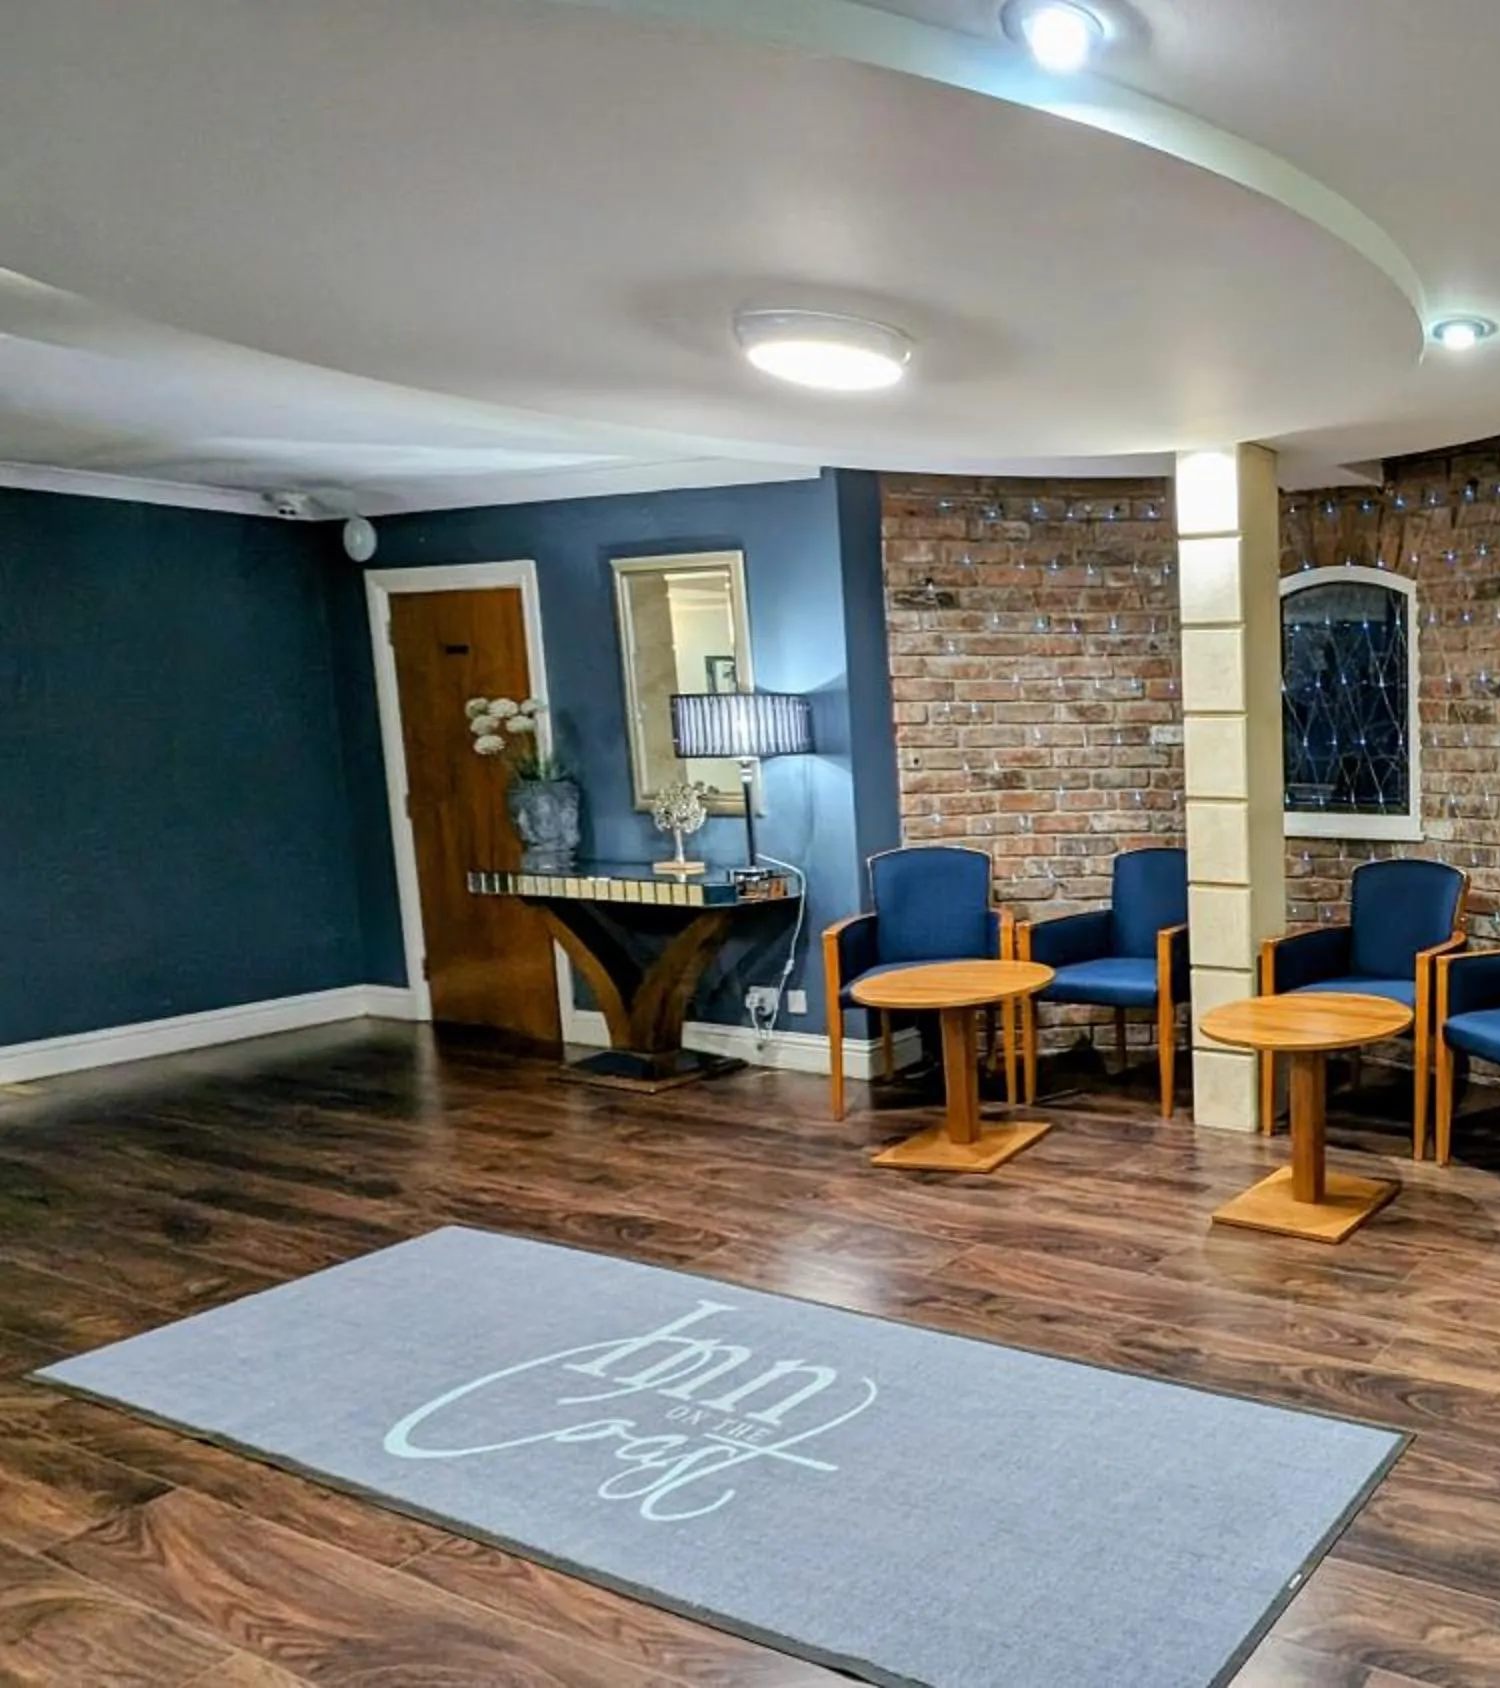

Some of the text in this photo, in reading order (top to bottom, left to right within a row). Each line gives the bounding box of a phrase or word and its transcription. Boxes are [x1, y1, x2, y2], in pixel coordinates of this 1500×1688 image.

[562, 1300, 837, 1425] Inn
[665, 1405, 774, 1441] ON THE
[383, 1335, 878, 1521] Coast
